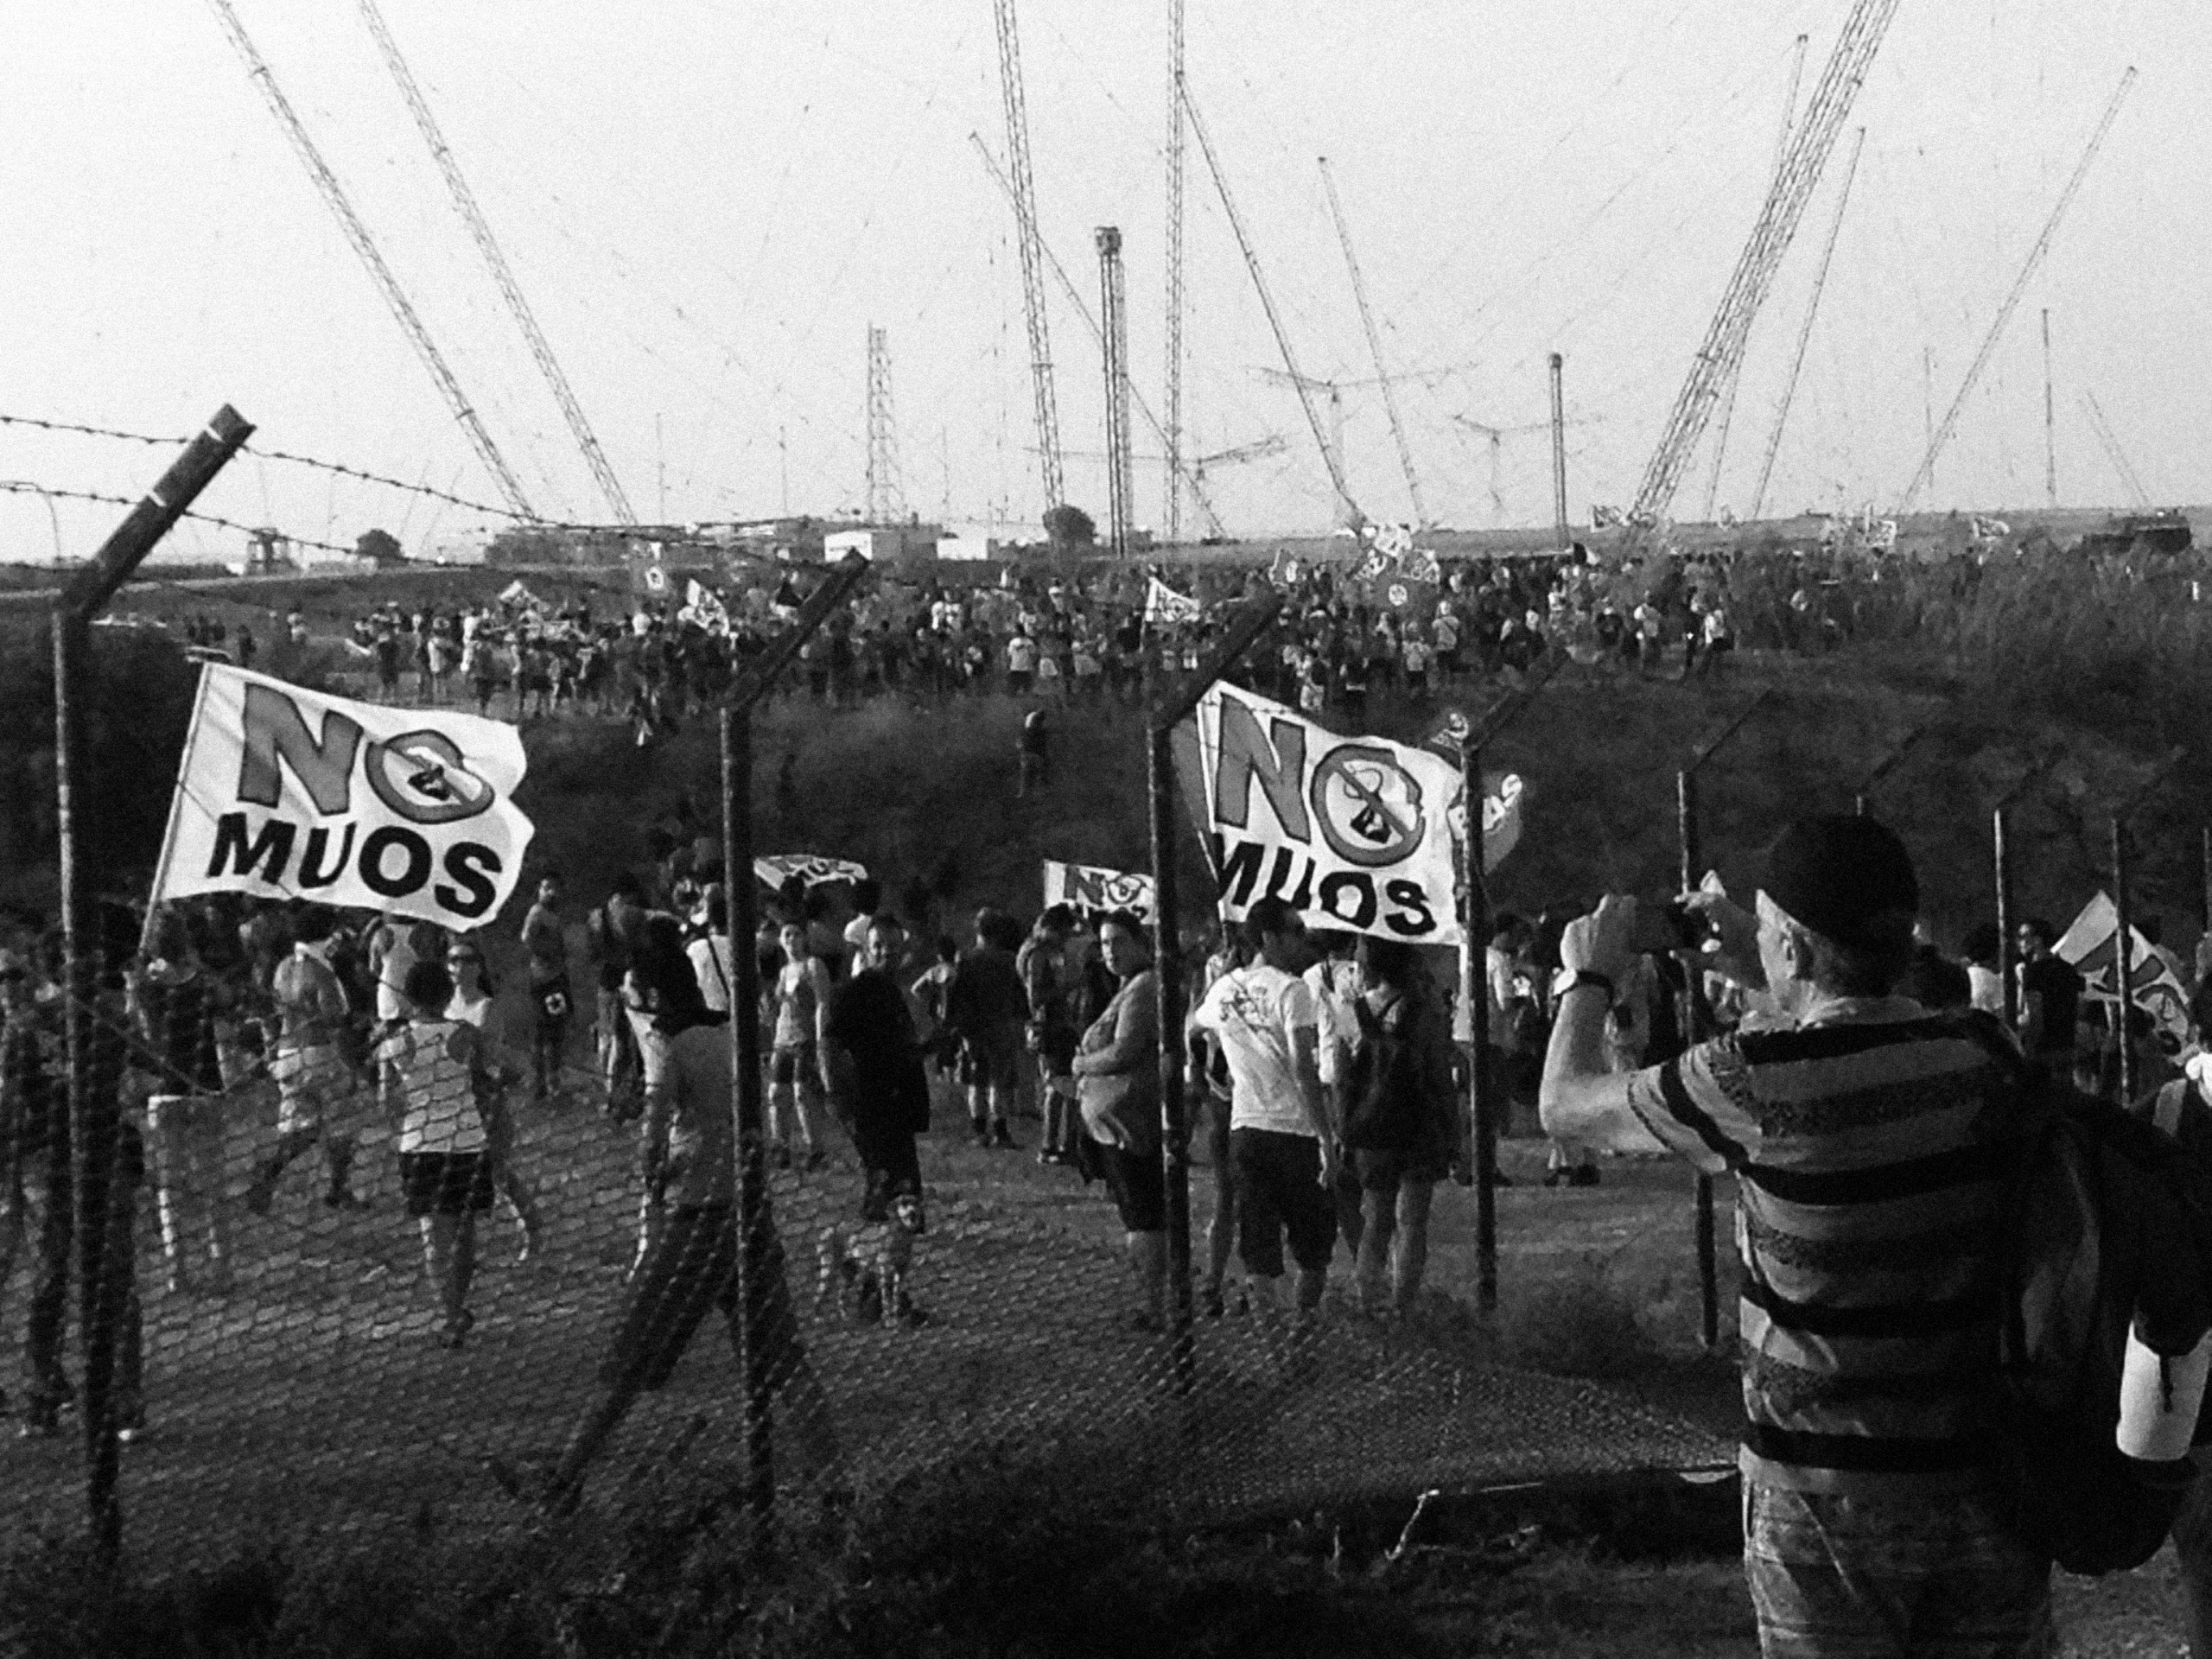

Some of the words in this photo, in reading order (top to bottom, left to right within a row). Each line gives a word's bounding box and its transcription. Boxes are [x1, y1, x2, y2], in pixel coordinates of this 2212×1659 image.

[237, 683, 495, 824] NO
[1215, 691, 1426, 867] NO
[206, 812, 502, 918] MUOS
[1211, 832, 1437, 936] MUOS
